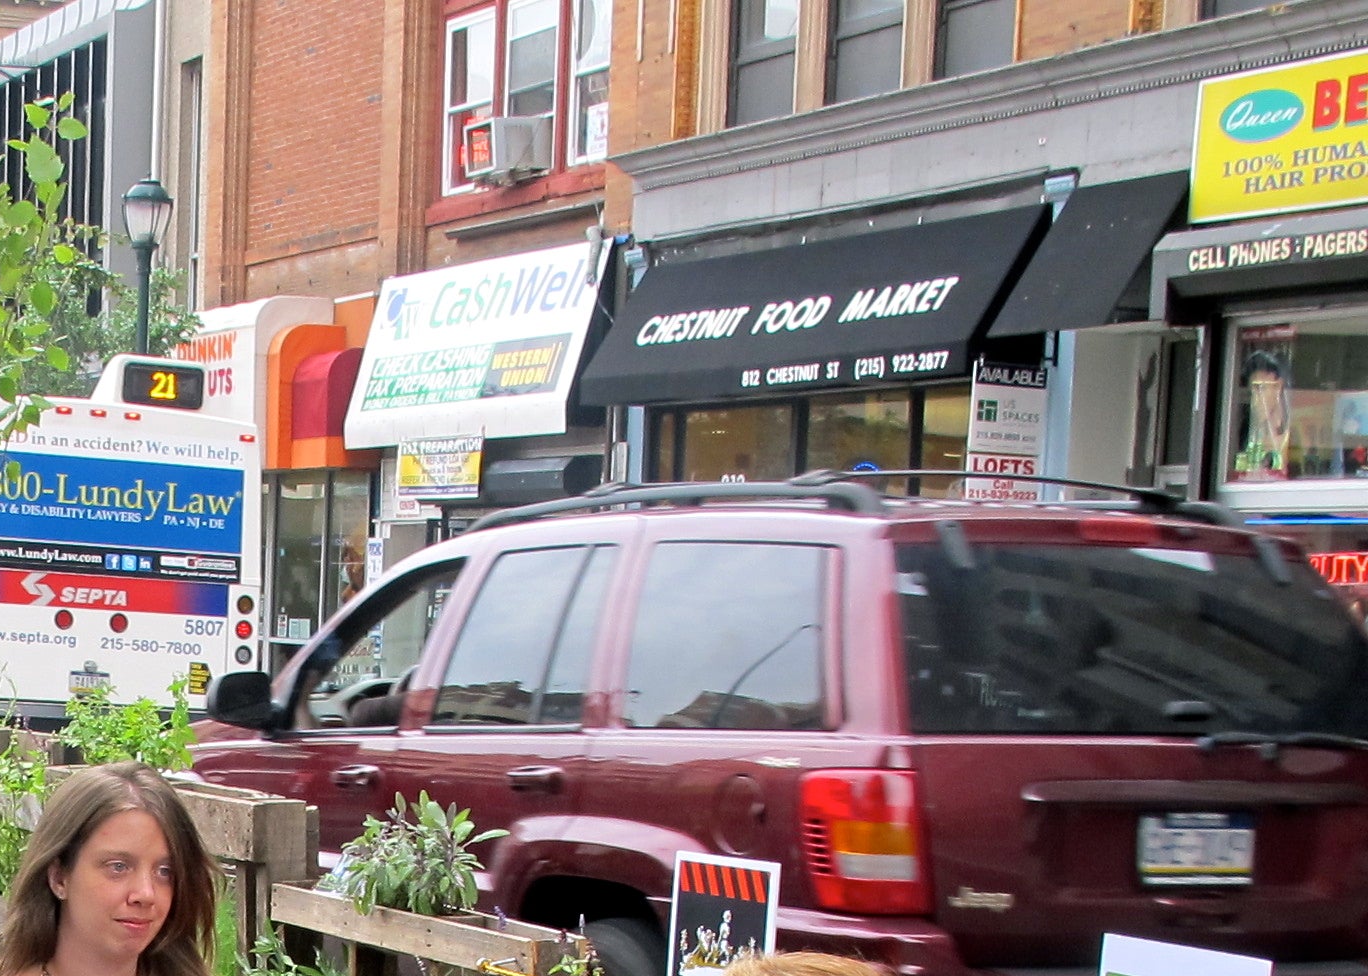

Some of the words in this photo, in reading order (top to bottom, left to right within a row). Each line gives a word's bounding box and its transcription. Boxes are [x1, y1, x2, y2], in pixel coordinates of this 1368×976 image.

[1225, 100, 1299, 131] Queen
[1222, 154, 1283, 178] 100%
[1243, 171, 1305, 195] HAIR
[1188, 246, 1226, 272] CELL
[1228, 237, 1292, 267] PHONES
[1302, 229, 1368, 259] PAGERS
[635, 306, 751, 347] CHESTNUT
[750, 295, 832, 335] FOOD
[837, 276, 960, 323] MARKET
[373, 351, 423, 378] CHECK
[420, 343, 491, 373] CASHING
[491, 347, 552, 371] WESTERN
[741, 370, 760, 387] 812
[766, 363, 820, 386] CHESTNUT
[826, 361, 840, 379] ST
[854, 356, 885, 380] (215)
[892, 350, 949, 372] 922-2877
[150, 371, 177, 399] 21
[208, 367, 233, 396] UTS
[366, 378, 393, 397] TAX
[391, 364, 487, 395] PREPARATION
[500, 365, 546, 387] UNION
[978, 366, 1045, 387] AVAILABLE
[1002, 409, 1040, 423] SPACES
[32, 431, 46, 445] in
[50, 436, 69, 447] an
[73, 436, 143, 453] accident?
[146, 440, 169, 455] We
[174, 444, 203, 458] will
[207, 446, 243, 465] help.
[973, 457, 1034, 476] LOFTS
[993, 479, 1014, 490] Call
[9, 501, 20, 515] &
[21, 503, 87, 520] DISABILITY
[87, 509, 142, 523] LAWYERS
[163, 515, 178, 525] PA
[187, 516, 200, 529] NJ
[209, 519, 225, 530] DE
[60, 587, 128, 607] SEPTA
[184, 620, 225, 636] 5807
[100, 637, 202, 656] 215-580-7800
